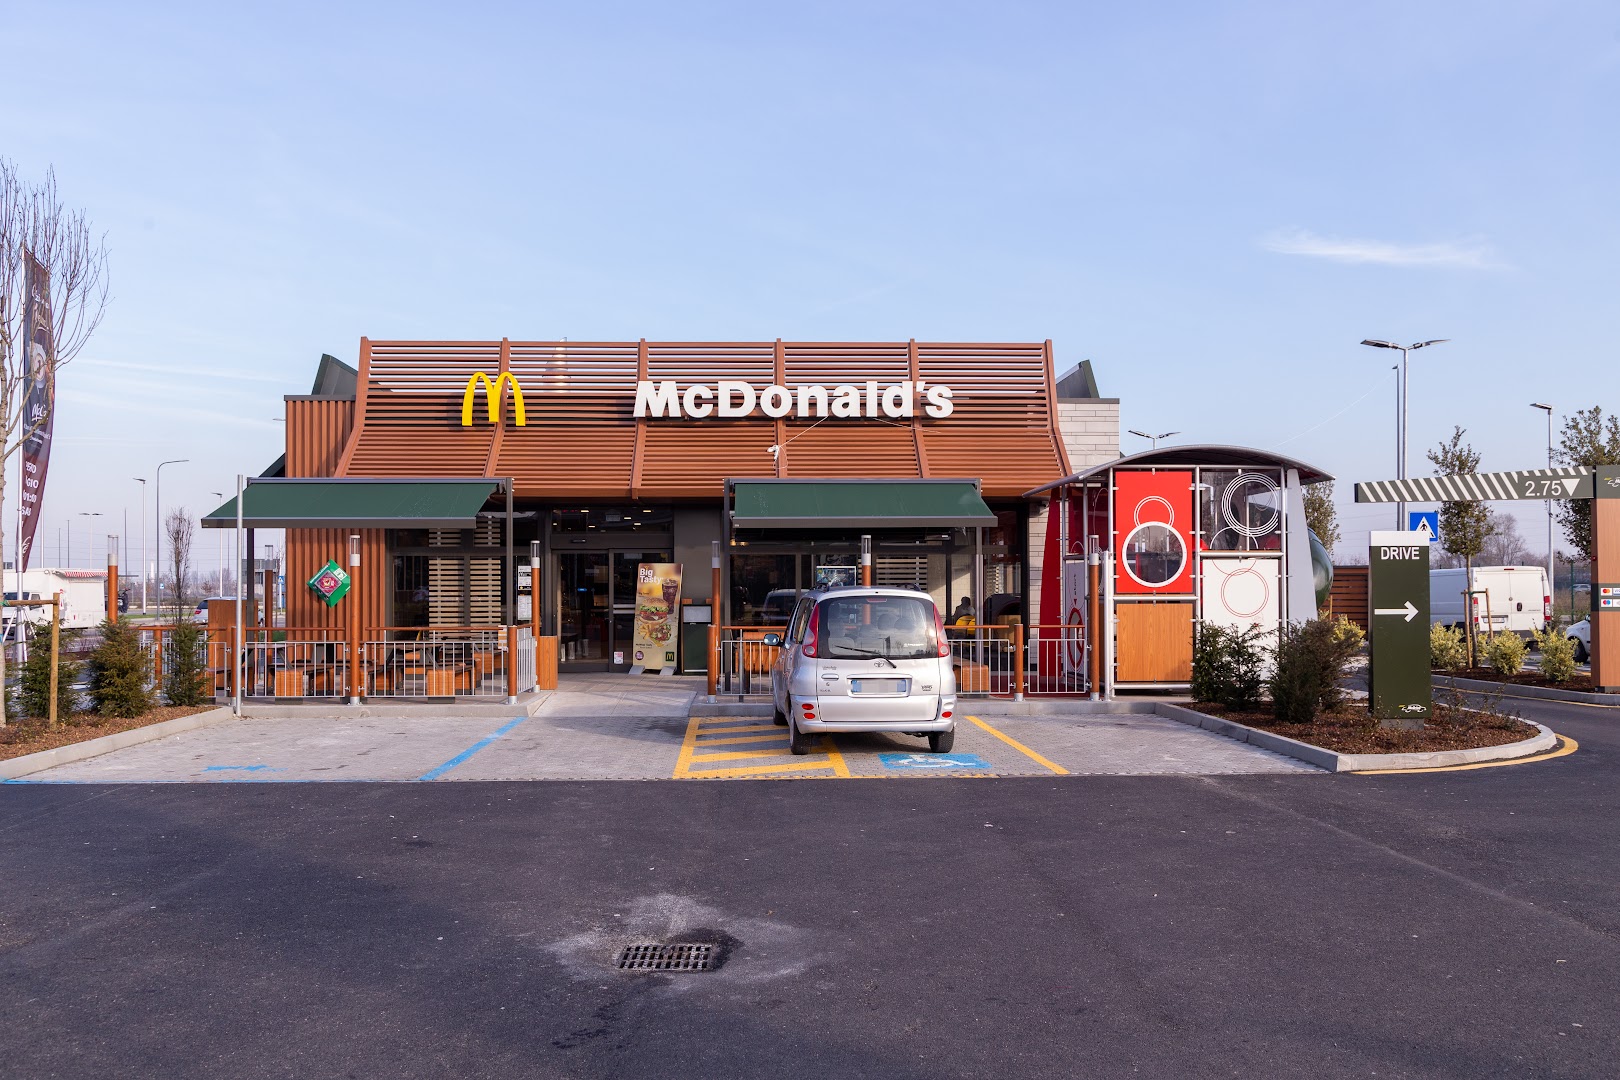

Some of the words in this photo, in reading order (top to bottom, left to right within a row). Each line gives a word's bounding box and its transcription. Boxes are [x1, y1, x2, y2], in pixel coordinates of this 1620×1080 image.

[632, 380, 954, 419] McDonald's
[1525, 480, 1562, 497] 2.75
[1380, 546, 1420, 560] DRIVE
[640, 568, 653, 577] Big
[640, 575, 662, 585] Tasty
